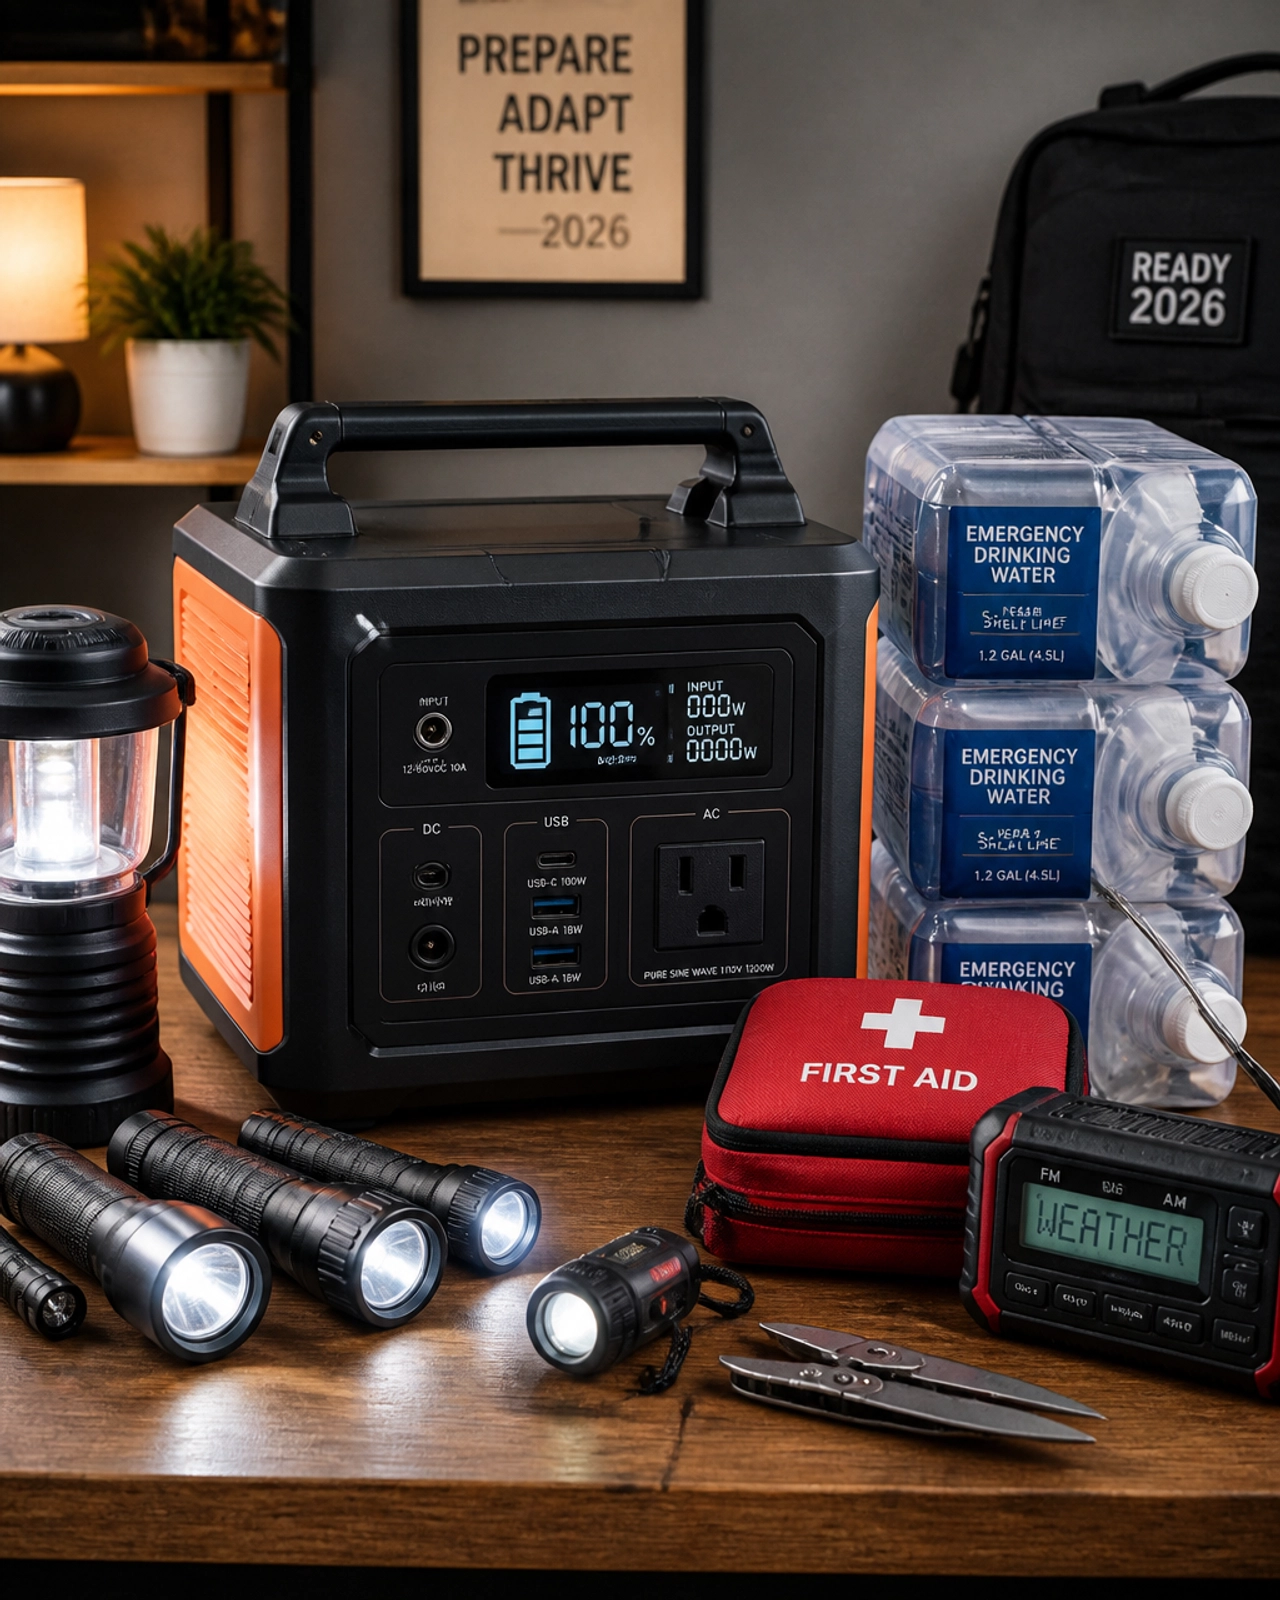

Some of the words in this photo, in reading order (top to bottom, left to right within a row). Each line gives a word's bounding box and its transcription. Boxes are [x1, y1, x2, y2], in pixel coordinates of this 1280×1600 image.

[458, 34, 633, 75] PREPARE
[498, 93, 633, 134] ADAPT
[494, 153, 633, 193] THRIVE
[1131, 251, 1232, 284] READY
[1129, 286, 1226, 327] 2026
[966, 525, 1085, 543] EMERGENCY
[974, 546, 1071, 564] DRINKING
[991, 567, 1056, 584] WATER
[979, 650, 998, 662] 1.2
[1000, 650, 1027, 662] GAL
[687, 681, 724, 693] INPUT
[687, 724, 736, 737] OUTPUT
[961, 748, 1079, 765] EMERGENCY
[970, 768, 1066, 786] DRINKING
[987, 789, 1051, 805] WATER
[544, 816, 569, 828] USB
[702, 808, 720, 820] AC
[422, 823, 441, 835] DC
[974, 870, 993, 882] 1.2
[996, 870, 1022, 882] GAL
[643, 970, 668, 980] PURE
[669, 968, 690, 979] SINE
[691, 966, 718, 977] WAVE
[960, 961, 1076, 978] EMERGENCY
[800, 1062, 905, 1086] FIRST
[913, 1067, 978, 1092] AID
[1040, 1167, 1061, 1183] FM
[1163, 1193, 1188, 1209] AM
[1037, 1194, 1188, 1266] WEATHER
